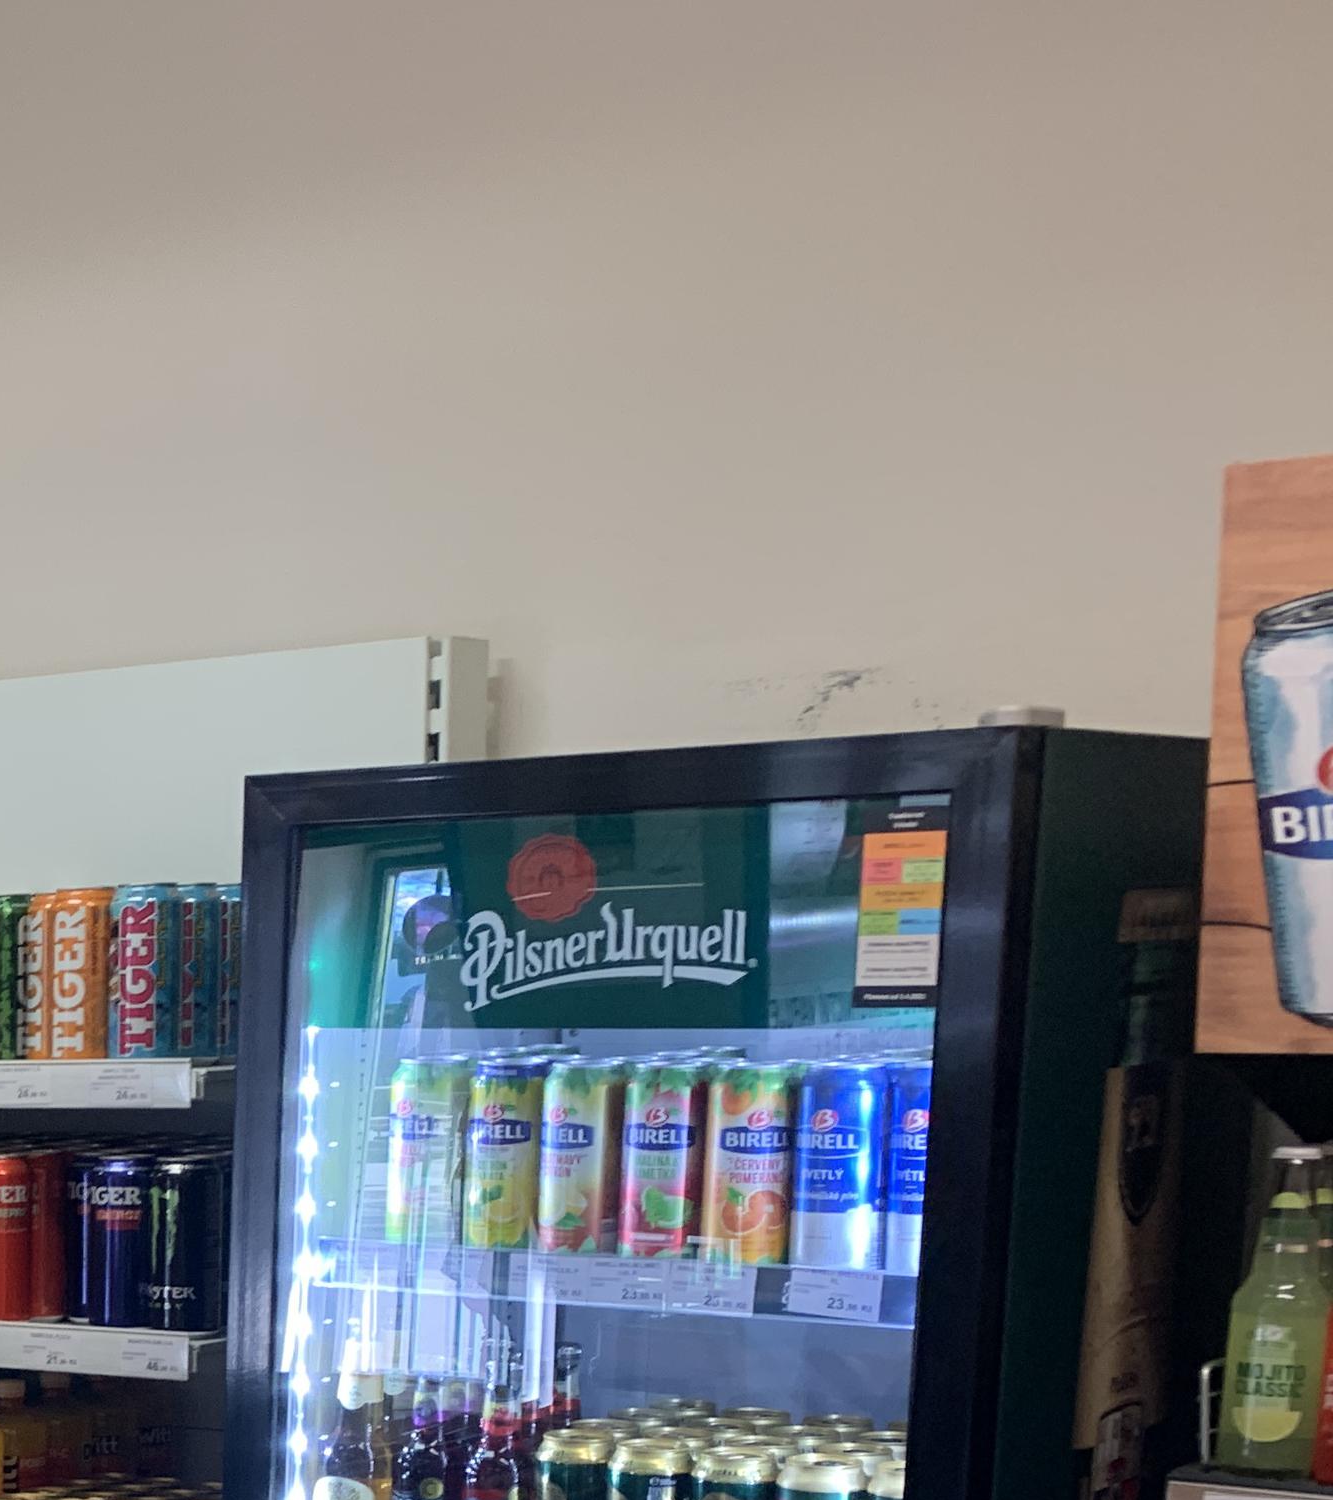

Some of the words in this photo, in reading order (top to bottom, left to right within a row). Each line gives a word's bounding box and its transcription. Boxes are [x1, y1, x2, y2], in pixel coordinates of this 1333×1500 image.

[52, 905, 86, 1058] TIGER
[117, 900, 156, 1057] TIGER
[459, 911, 606, 1012] Pilsner
[600, 901, 748, 989] Urquell
